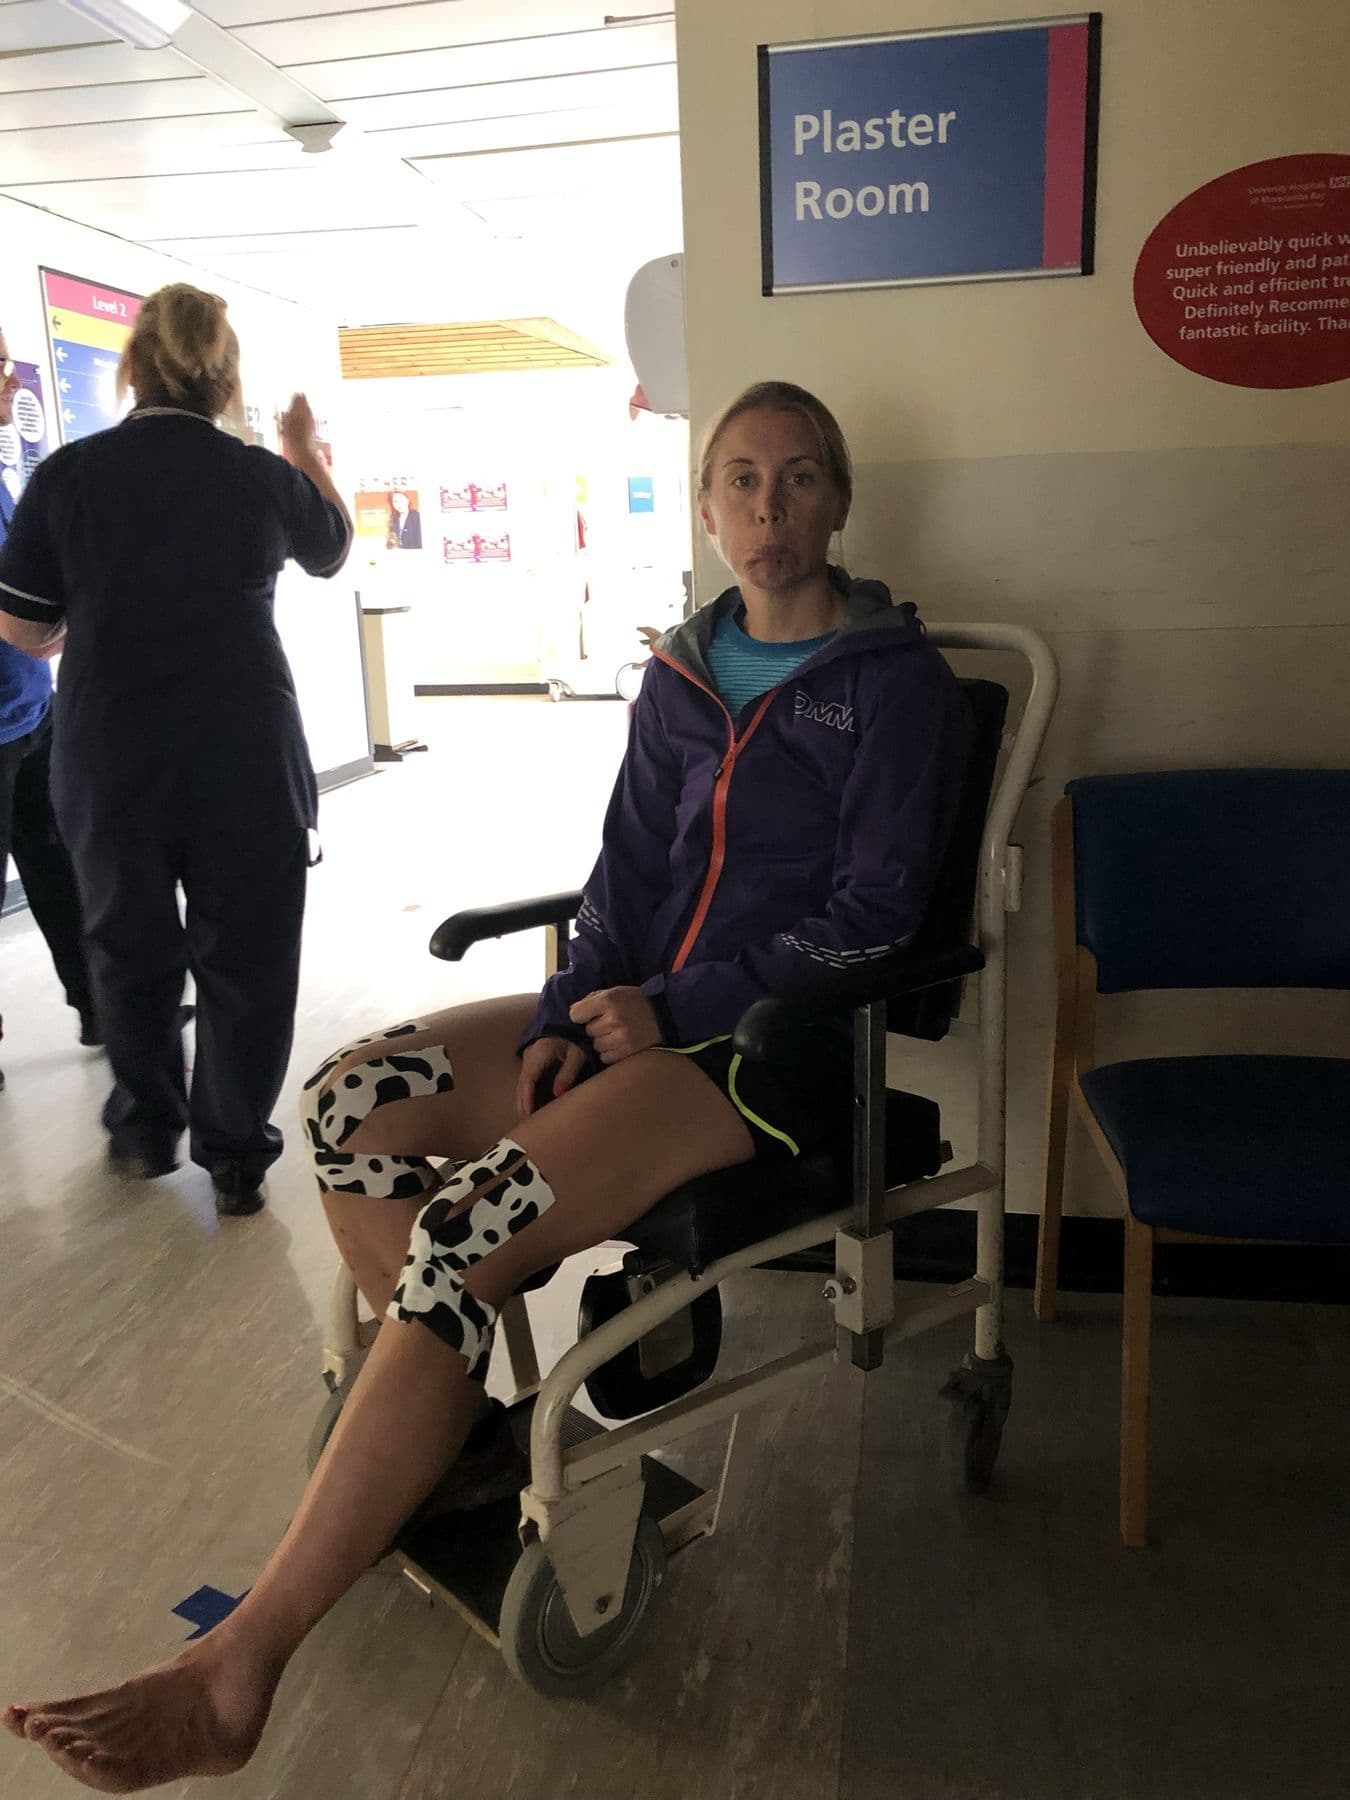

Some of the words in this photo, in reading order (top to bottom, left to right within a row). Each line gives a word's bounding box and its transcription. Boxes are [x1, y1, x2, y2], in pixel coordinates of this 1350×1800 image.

[794, 108, 957, 156] Plaster
[795, 180, 930, 222] Room
[1175, 236, 1284, 258] Unbelievably
[1288, 232, 1333, 251] quick
[1166, 264, 1212, 281] super
[1216, 257, 1281, 276] friendly
[1285, 254, 1317, 271] and
[1172, 283, 1218, 301] Quick
[1223, 280, 1254, 296] and
[1259, 275, 1328, 294] efficient
[92, 295, 118, 315] Level
[120, 303, 128, 318] 2
[1184, 302, 1264, 320] Definitely
[1178, 323, 1249, 341] fantastic
[1254, 319, 1312, 336] facility.
[1318, 316, 1350, 331] Tha
